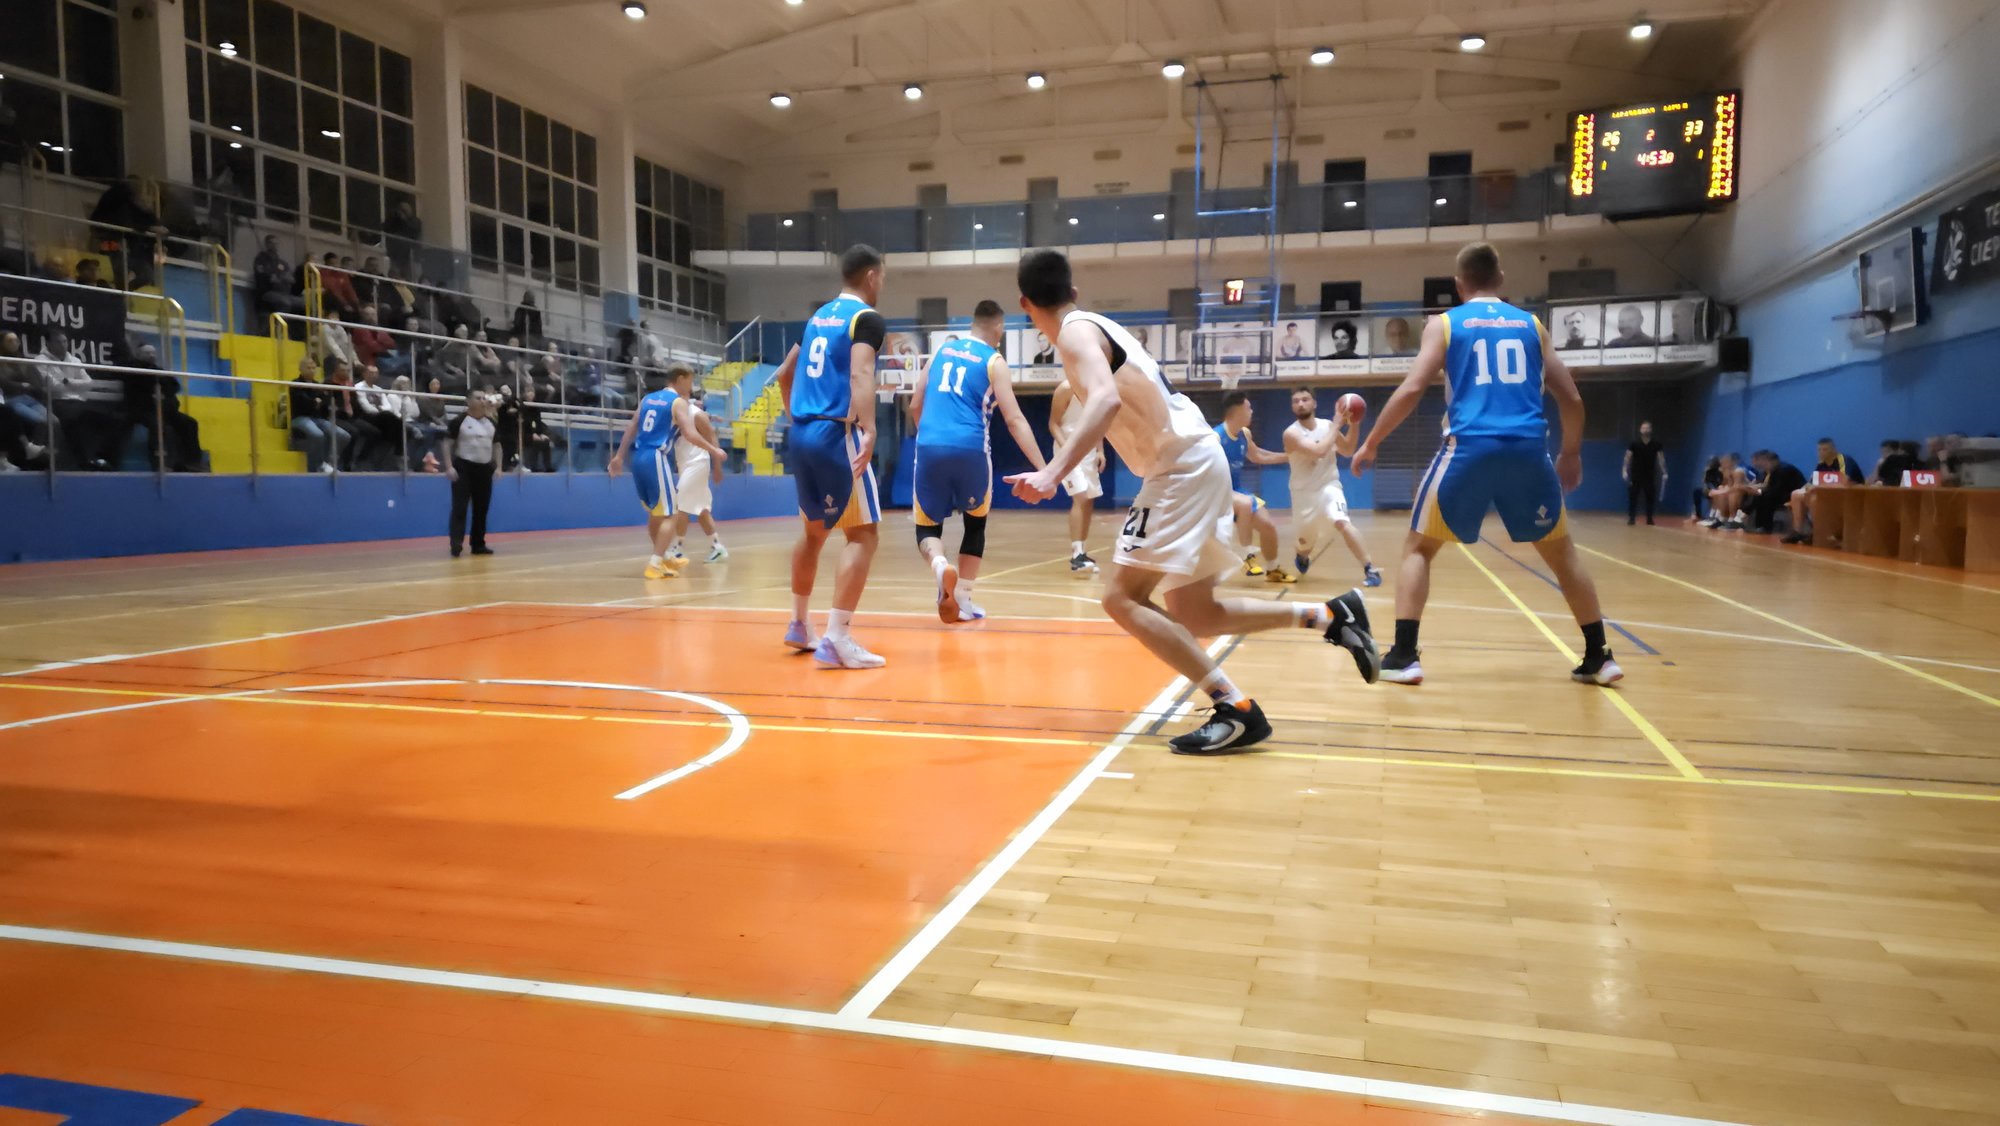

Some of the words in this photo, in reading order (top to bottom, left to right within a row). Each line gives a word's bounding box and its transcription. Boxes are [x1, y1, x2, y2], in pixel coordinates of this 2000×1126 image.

[1602, 131, 1620, 147] 26
[1646, 129, 1655, 141] 2
[1684, 120, 1704, 136] 33
[806, 336, 828, 378] 9
[1472, 338, 1527, 386] 10
[937, 362, 967, 397] 11
[642, 409, 657, 433] 6
[1122, 506, 1150, 539] 21
